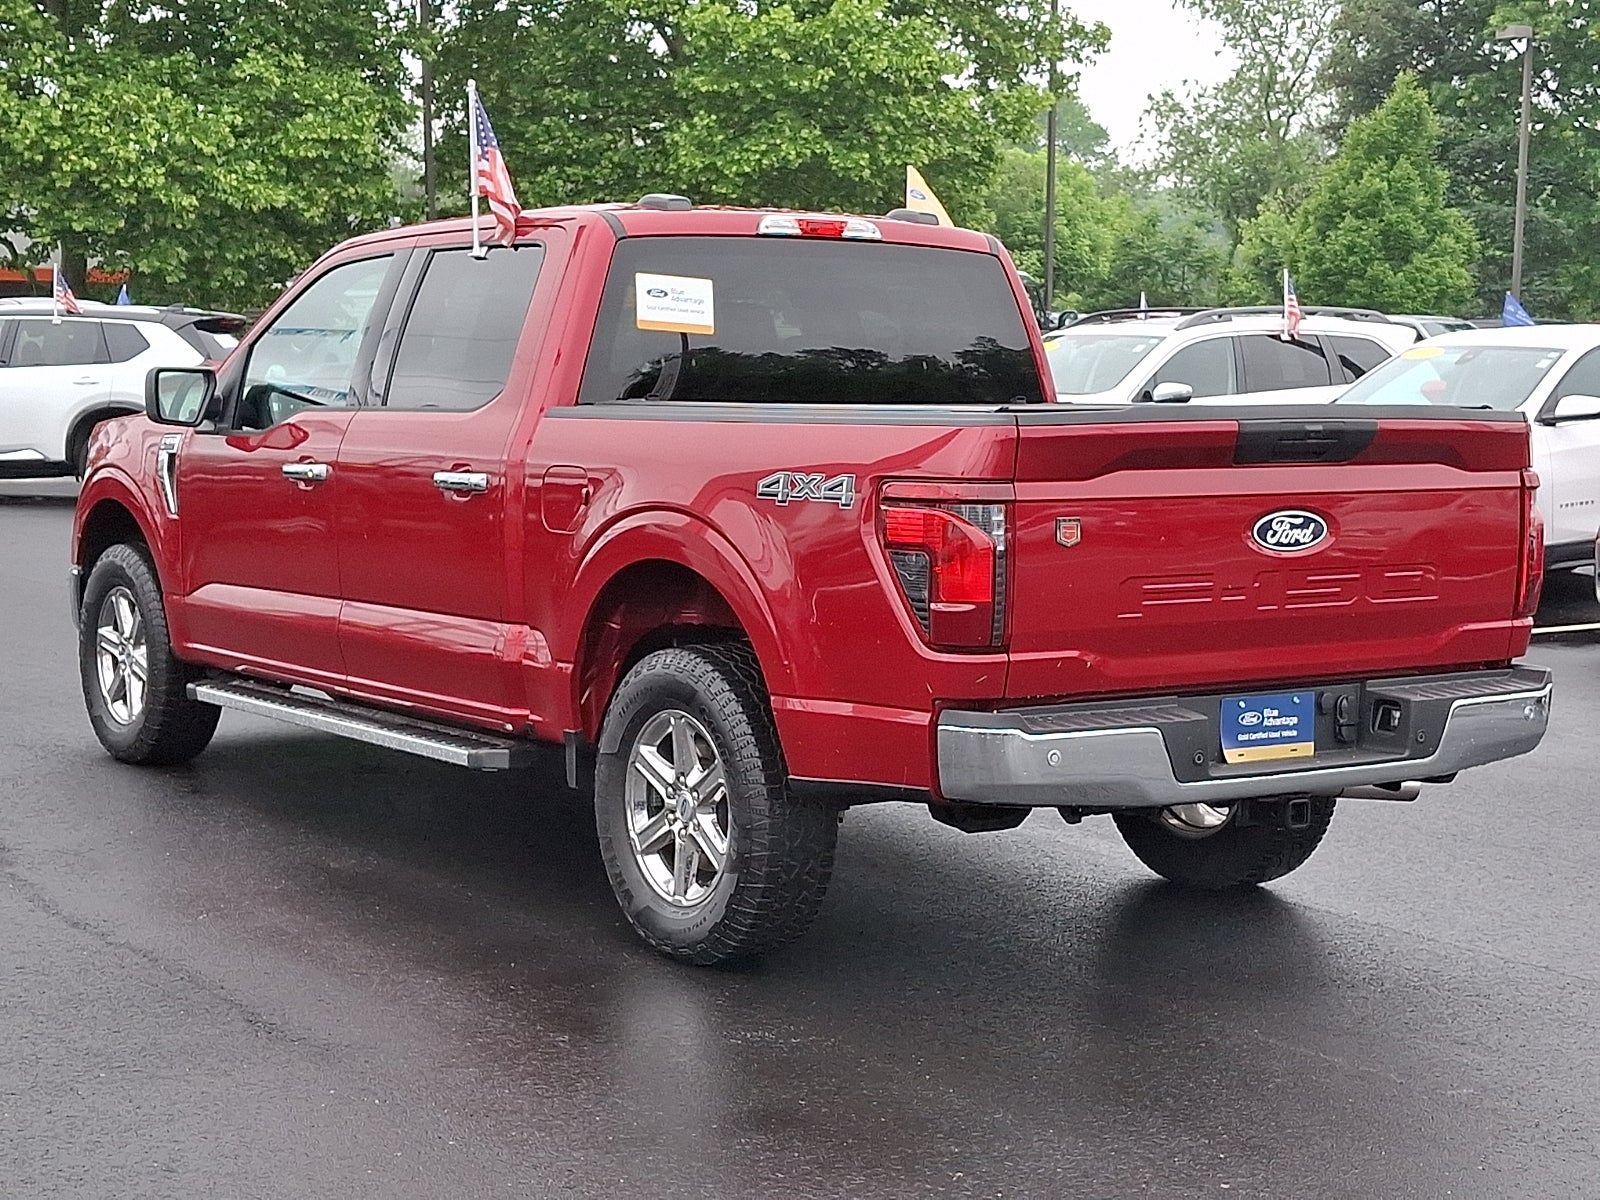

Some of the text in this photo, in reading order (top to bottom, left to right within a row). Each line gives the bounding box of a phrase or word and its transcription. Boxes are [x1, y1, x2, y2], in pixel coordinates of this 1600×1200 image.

[1266, 516, 1315, 544] Ford
[1117, 562, 1440, 618] F-150
[1263, 716, 1298, 727] Advantage
